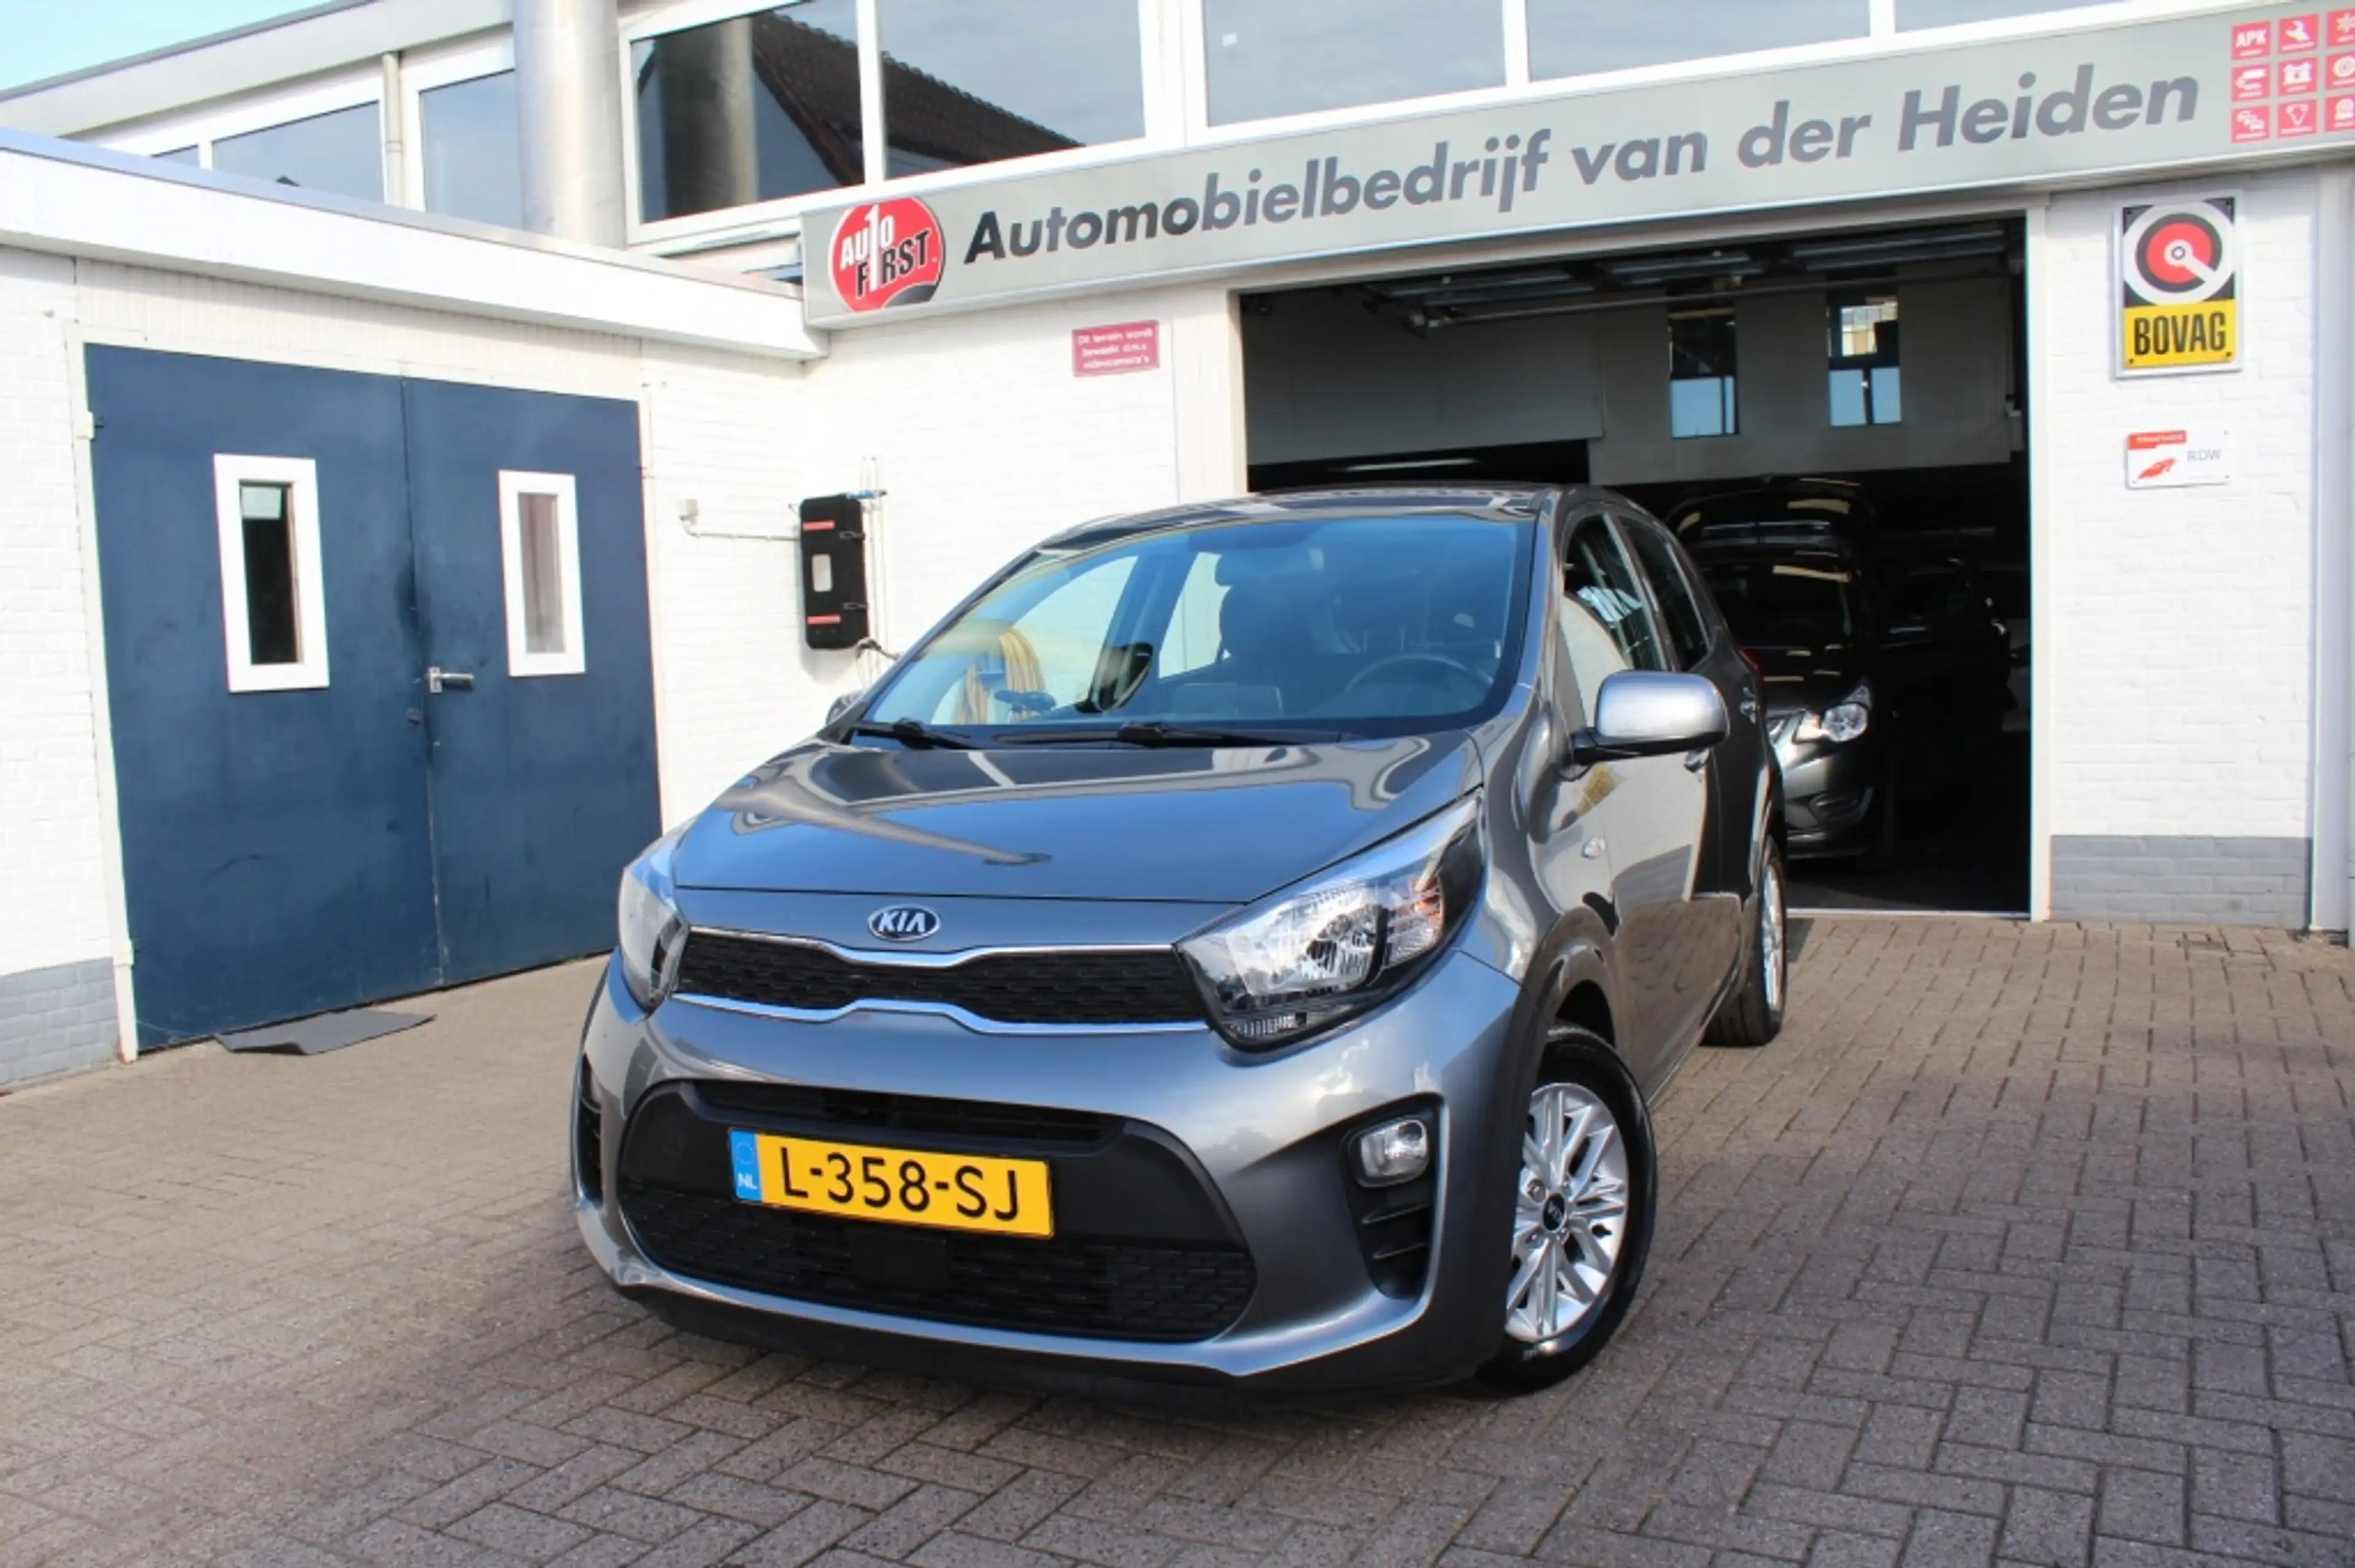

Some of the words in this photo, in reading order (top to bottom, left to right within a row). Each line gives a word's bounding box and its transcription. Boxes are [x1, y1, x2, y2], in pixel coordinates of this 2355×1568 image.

[963, 128, 1552, 264] Automobielbedrijf
[1570, 130, 1707, 185] van
[1737, 100, 1873, 167] der
[1897, 63, 2199, 152] Heiden
[2134, 311, 2226, 356] BOVAG
[2186, 448, 2223, 462] RDW
[878, 910, 925, 932] KIA
[737, 1172, 758, 1190] NL
[781, 1146, 1020, 1221] L-358-SJ
